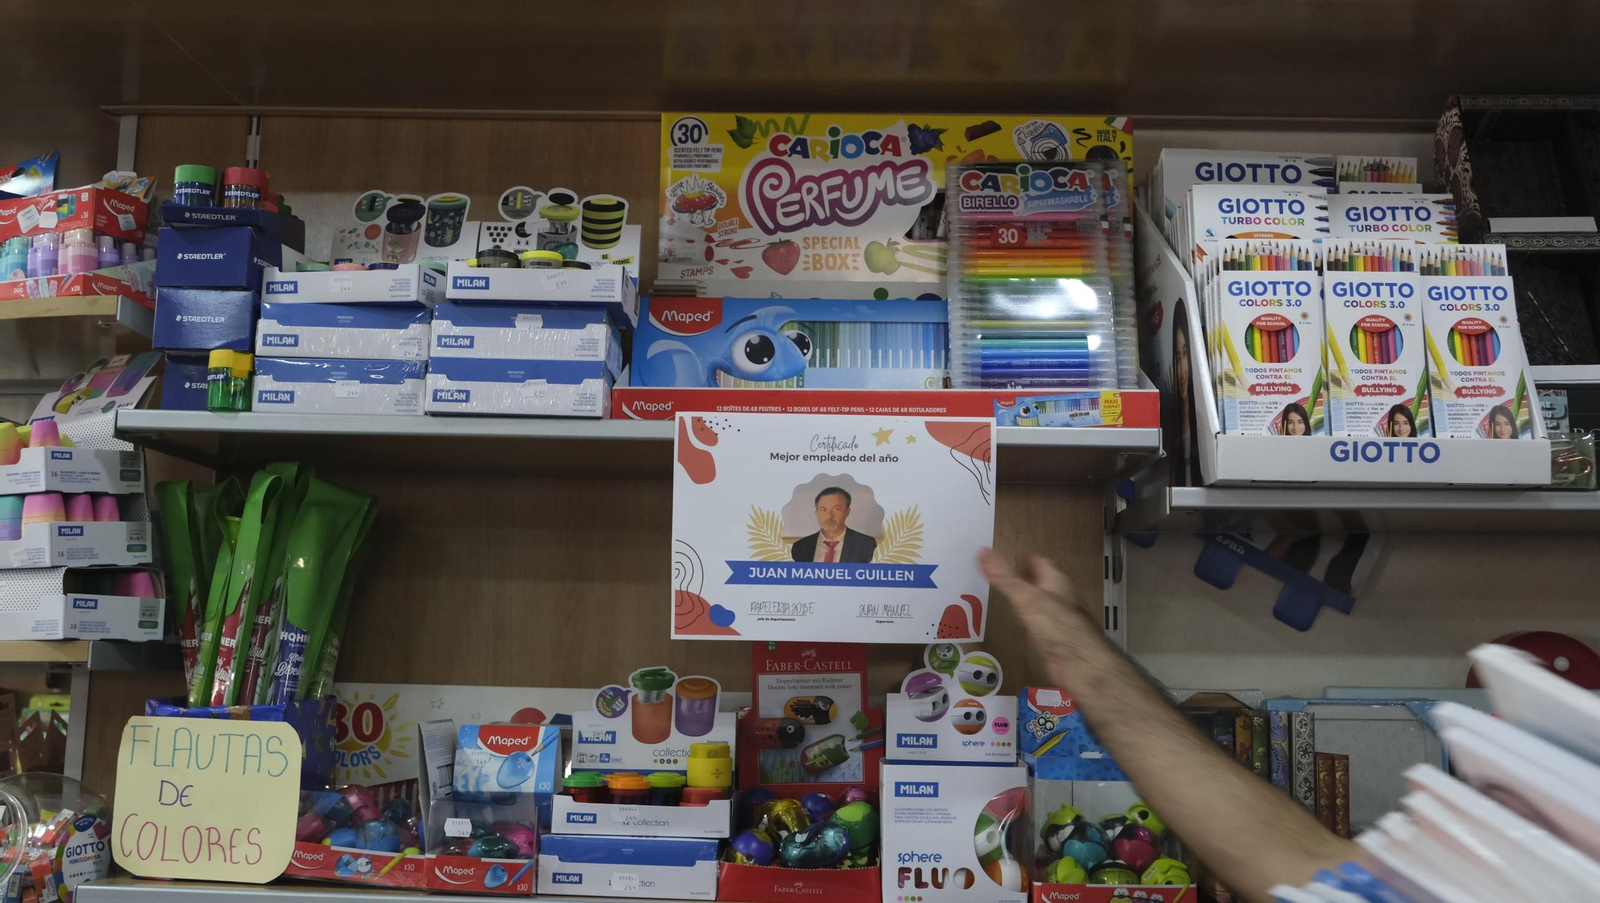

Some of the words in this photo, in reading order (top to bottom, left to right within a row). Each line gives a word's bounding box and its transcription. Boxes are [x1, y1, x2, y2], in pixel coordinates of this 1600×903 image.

[678, 123, 702, 144] 30
[768, 126, 902, 162] CARIOCA
[1195, 162, 1302, 184] GIOTTO
[961, 164, 1089, 195] CARIOCA
[178, 188, 210, 196] STAEDTLER
[228, 190, 259, 200] STAEDTLER
[751, 162, 928, 232] PERFUME
[110, 199, 136, 213] Maped
[963, 197, 1018, 208] BIRELLO
[1027, 194, 1088, 208] SUPERWASHABLE
[1218, 198, 1305, 216] GIOTTO
[191, 212, 236, 222] STAEDTLER
[1344, 206, 1432, 222] GIOTTO
[718, 219, 739, 230] DOUBLE
[1220, 216, 1262, 225] TURBO
[1264, 216, 1305, 226] COLOR
[718, 228, 738, 238] STROKE
[1348, 224, 1390, 232] TURBO
[1392, 224, 1432, 232] COLOR
[998, 228, 1019, 244] 30
[802, 236, 862, 250] SPECIAL
[812, 253, 852, 271] BOX
[680, 266, 714, 279] STAMPS
[97, 282, 117, 292] Maped
[269, 284, 295, 292] MILAN
[456, 278, 486, 288] MILAN
[1227, 280, 1312, 297] GIOTTO
[1332, 281, 1414, 298] GIOTTO
[1428, 285, 1508, 302] GIOTTO
[1239, 299, 1283, 308] COLORS
[1286, 299, 1302, 308] 3.0
[1344, 300, 1386, 308] COLORS
[1390, 300, 1406, 309] 3.0
[1439, 304, 1482, 312] COLORS
[1484, 304, 1500, 312] 3.0
[182, 315, 225, 323] STAEDTLER
[662, 310, 710, 324] Maped
[267, 336, 295, 345] MILAN
[442, 338, 470, 346] MILAN
[263, 393, 290, 401] MILAN
[438, 392, 467, 400] MILAN
[632, 400, 672, 412] Maped
[810, 434, 859, 452] Certificado
[770, 452, 800, 462] Mejor
[802, 452, 857, 463] empleado
[859, 452, 876, 462] del
[878, 453, 899, 463] año
[1330, 440, 1440, 464] GIOTTO
[1222, 540, 1245, 555] FILA
[748, 567, 788, 579] JUAN
[791, 568, 852, 580] MANUEL
[855, 568, 914, 582] GUILLEN
[75, 600, 96, 608] MILAN
[858, 604, 879, 616] JUAN
[881, 604, 912, 618] MANUEL
[766, 658, 854, 671] FABER-CASTELL
[487, 735, 529, 746] Maped
[902, 736, 933, 745] MILAN
[130, 724, 289, 778] FLAUTAS
[538, 782, 551, 790] x30
[900, 785, 934, 794] MILAN
[158, 780, 194, 808] DE
[120, 814, 263, 866] COLORES
[66, 841, 105, 858] GIOTTO
[293, 850, 324, 861] Maped
[897, 850, 942, 865] sphere
[443, 865, 475, 876] Maped
[556, 874, 580, 882] MILAN
[898, 867, 976, 890] FLUO
[774, 884, 823, 894] FABER-CASTELL
[1050, 891, 1080, 901] Maped
